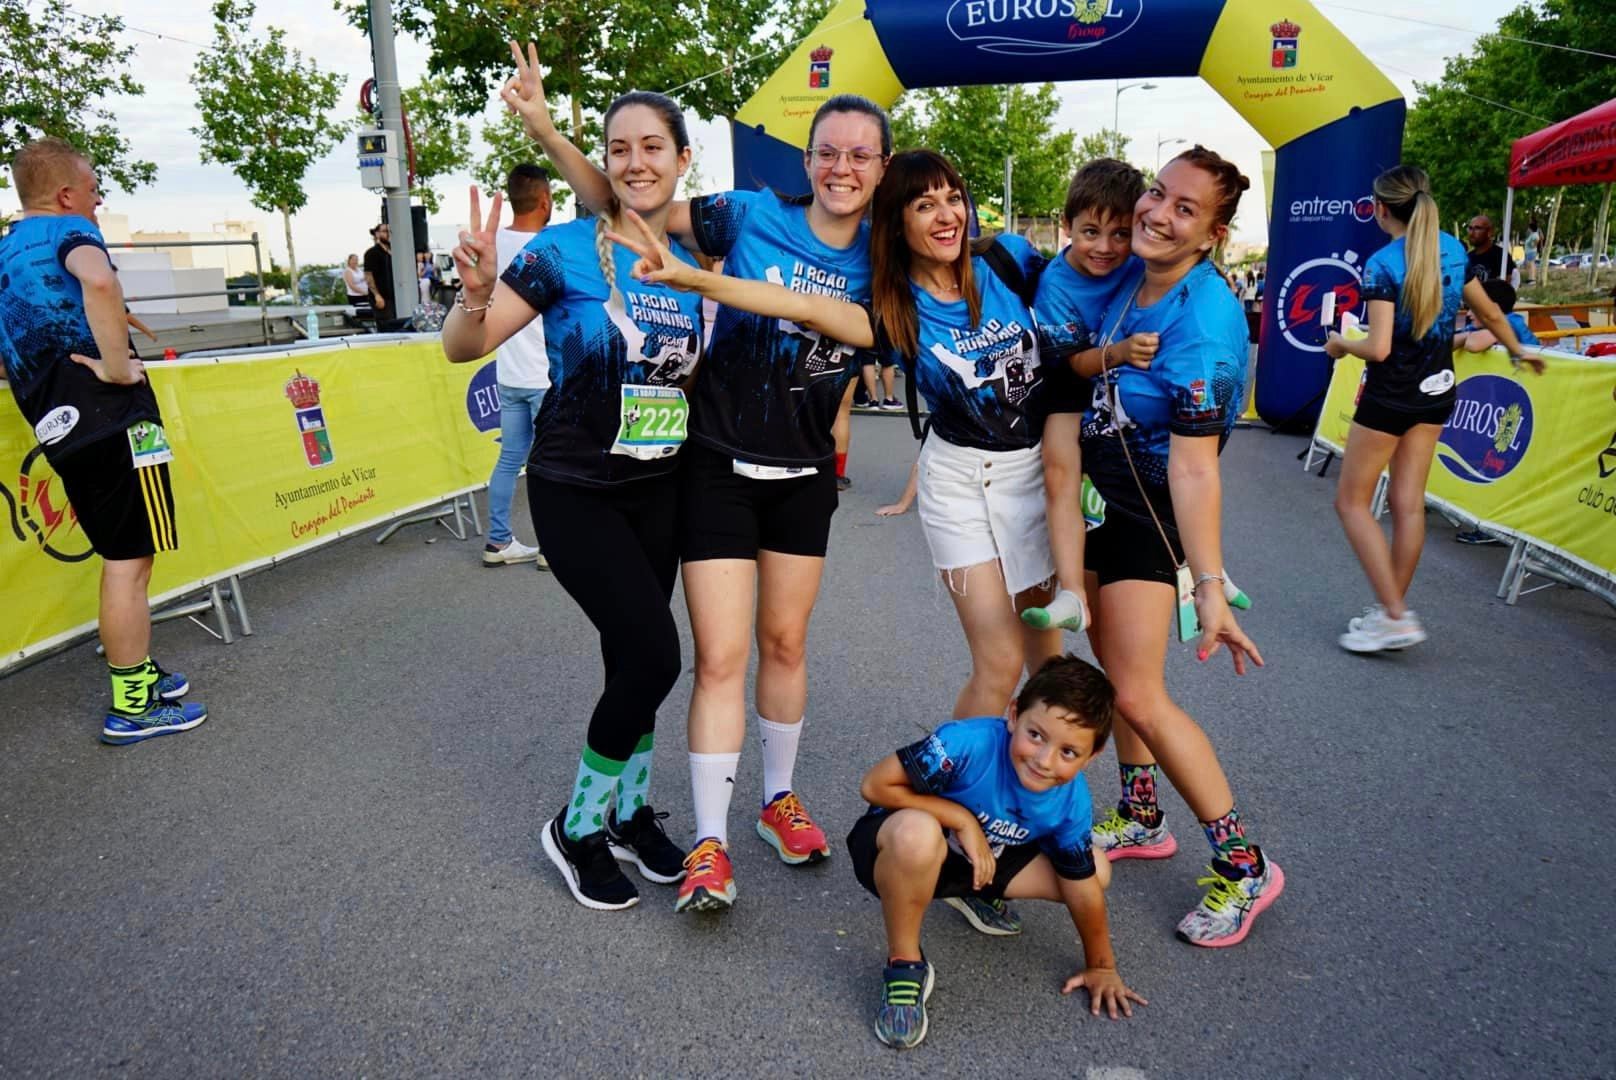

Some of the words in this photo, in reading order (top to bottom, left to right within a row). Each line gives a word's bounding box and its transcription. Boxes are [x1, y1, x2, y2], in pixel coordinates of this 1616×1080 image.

[1237, 74, 1295, 86] Ayuntamiento
[1296, 73, 1307, 82] de
[807, 265, 847, 289] ROAD
[639, 293, 679, 312] ROAD
[632, 305, 694, 330] RUNNING
[955, 321, 1022, 354] RUNNING
[641, 407, 685, 437] 222
[274, 480, 340, 510] Ayuntamiento
[341, 472, 352, 487] de
[1577, 484, 1604, 509] club
[328, 499, 341, 520] del
[988, 818, 1030, 840] ROAD
